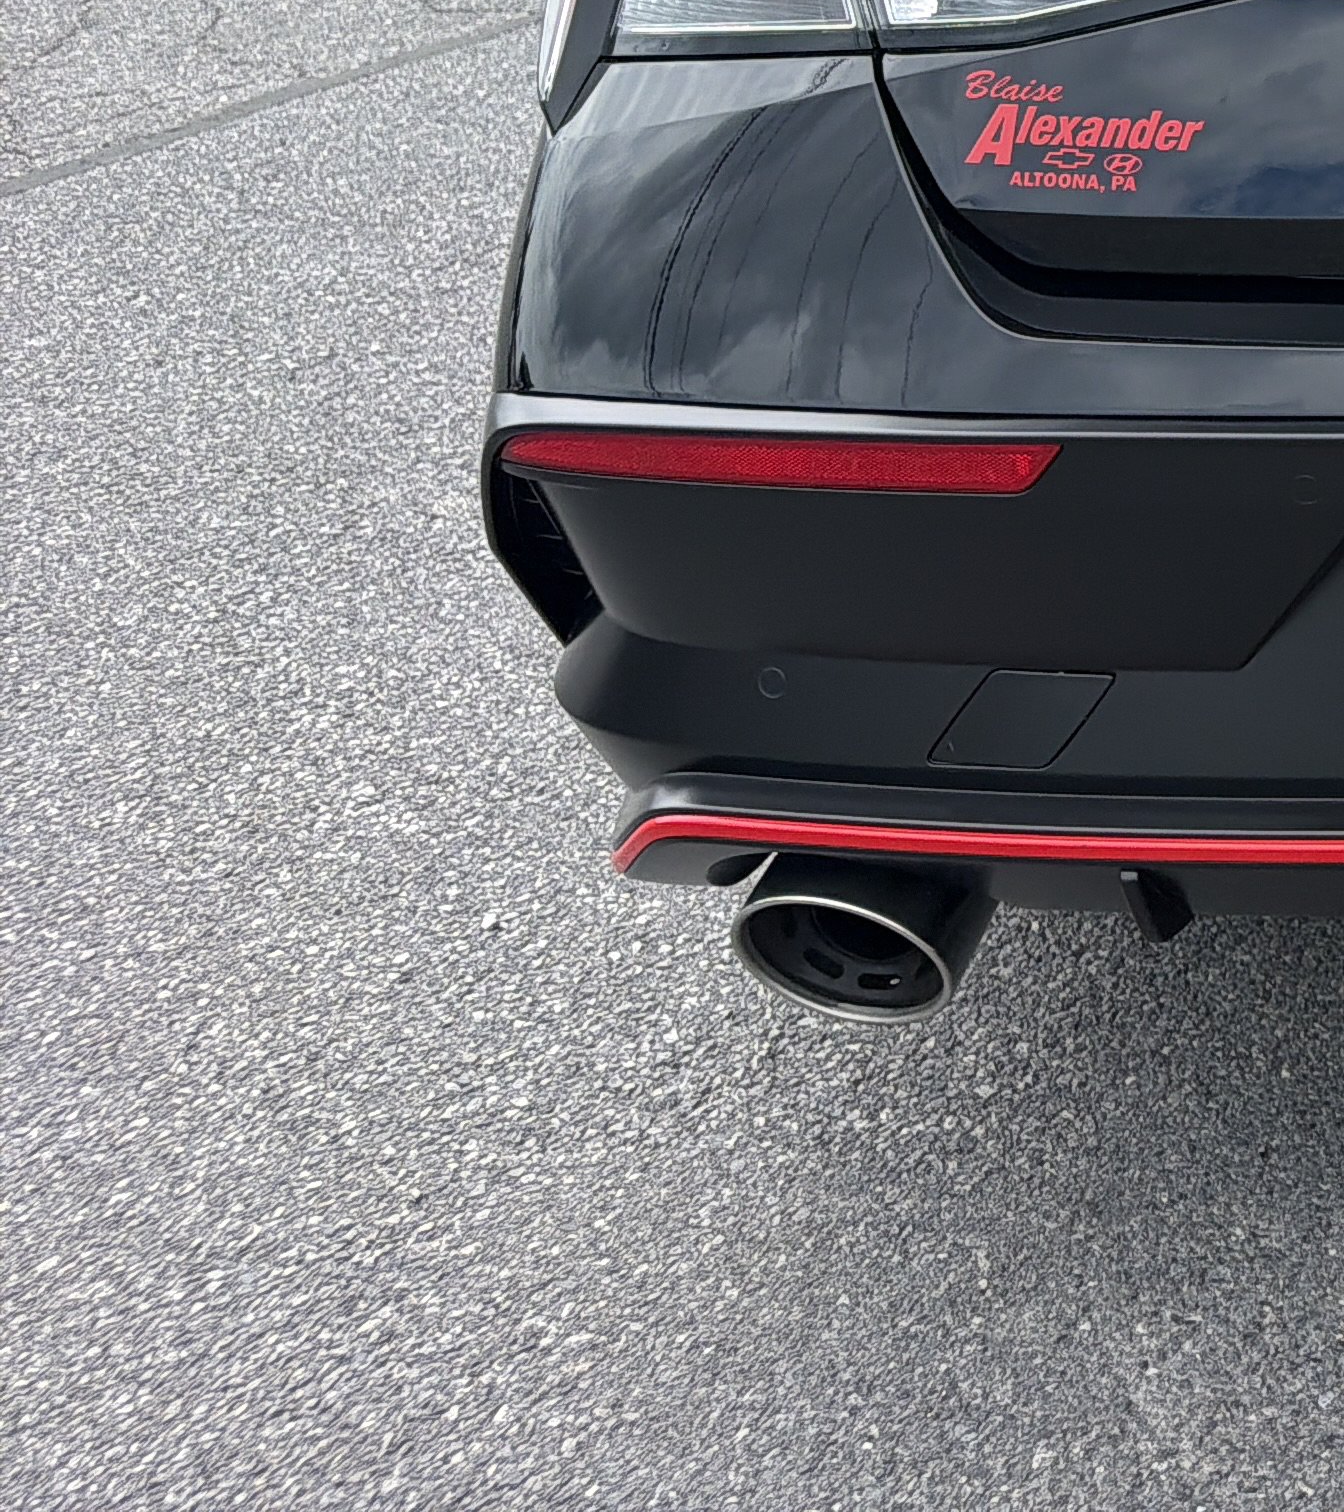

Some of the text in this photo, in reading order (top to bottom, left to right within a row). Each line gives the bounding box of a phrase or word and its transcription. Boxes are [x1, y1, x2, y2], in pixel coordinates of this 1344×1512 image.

[964, 69, 1065, 104] Blaise
[964, 103, 1206, 167] Alexander
[1008, 170, 1137, 194] ALTOONA, PA
